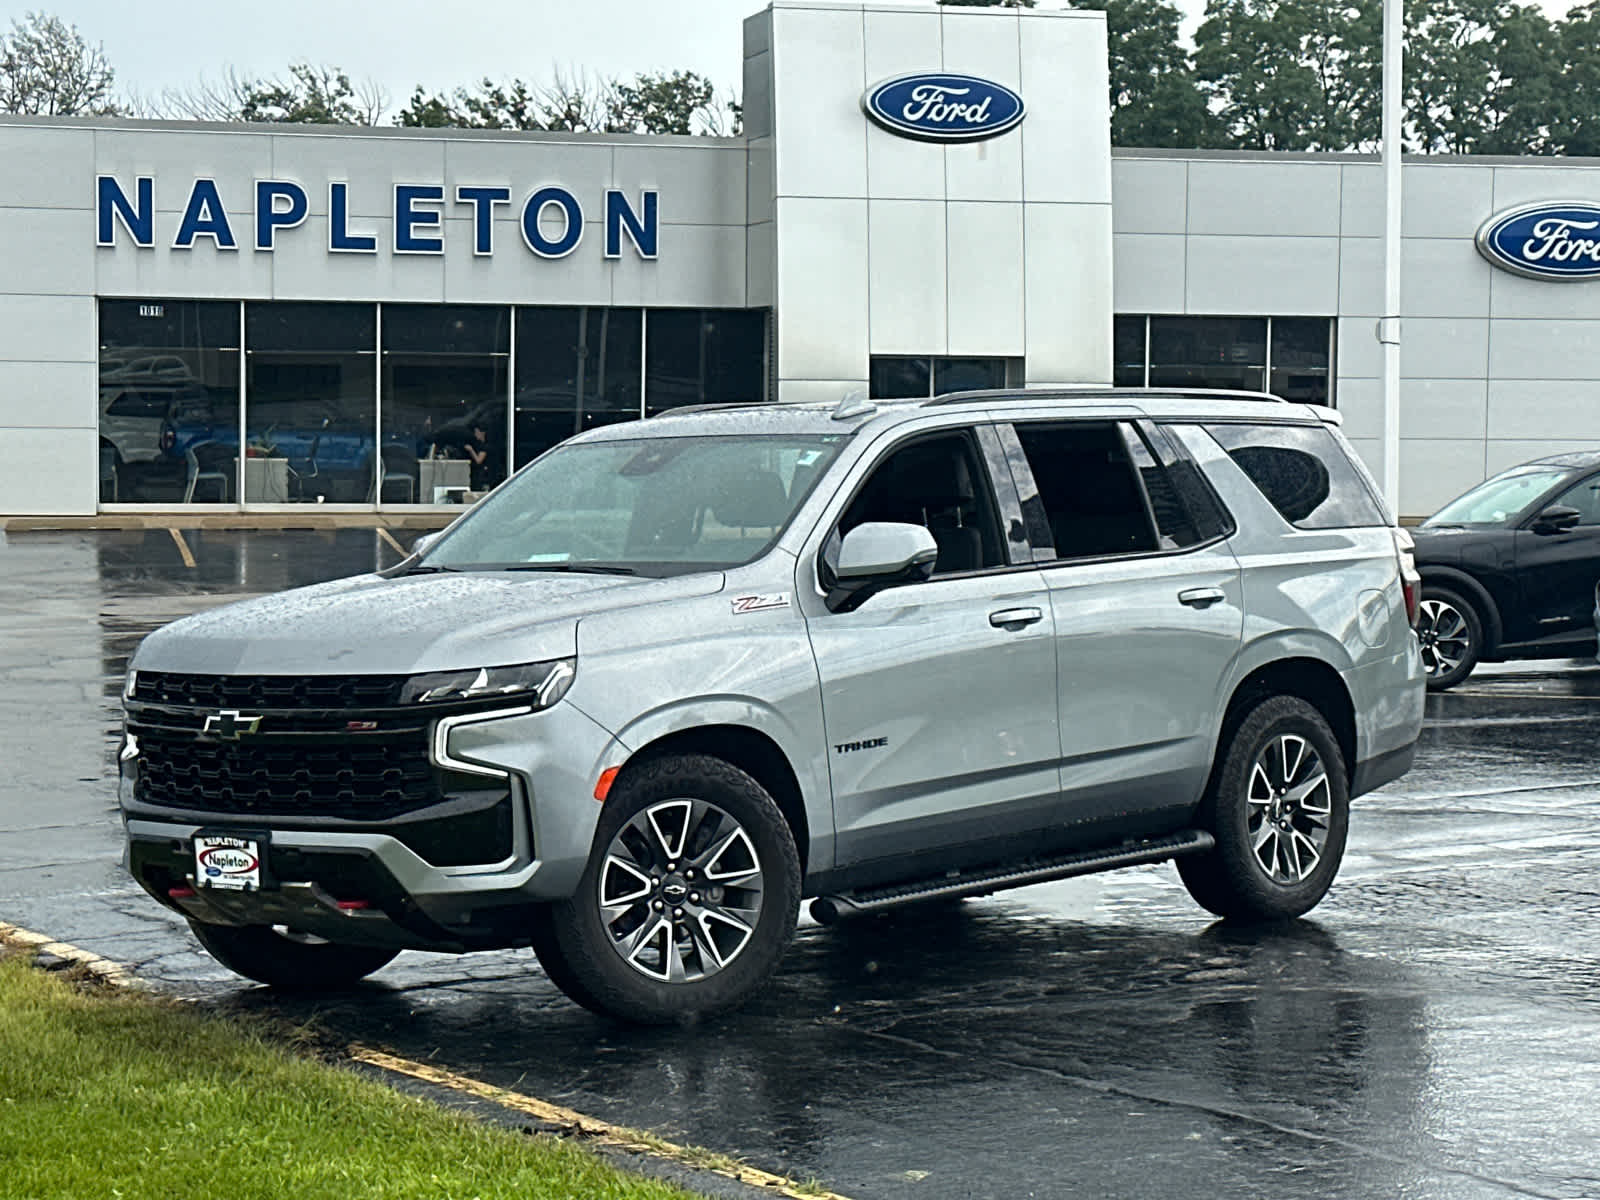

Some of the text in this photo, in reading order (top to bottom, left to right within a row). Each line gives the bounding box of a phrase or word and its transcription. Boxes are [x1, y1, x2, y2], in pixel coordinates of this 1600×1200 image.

[902, 84, 992, 123] Ford
[95, 173, 660, 261] NAPLETON
[834, 736, 888, 754] TAHOE
[208, 851, 250, 869] Napleton
